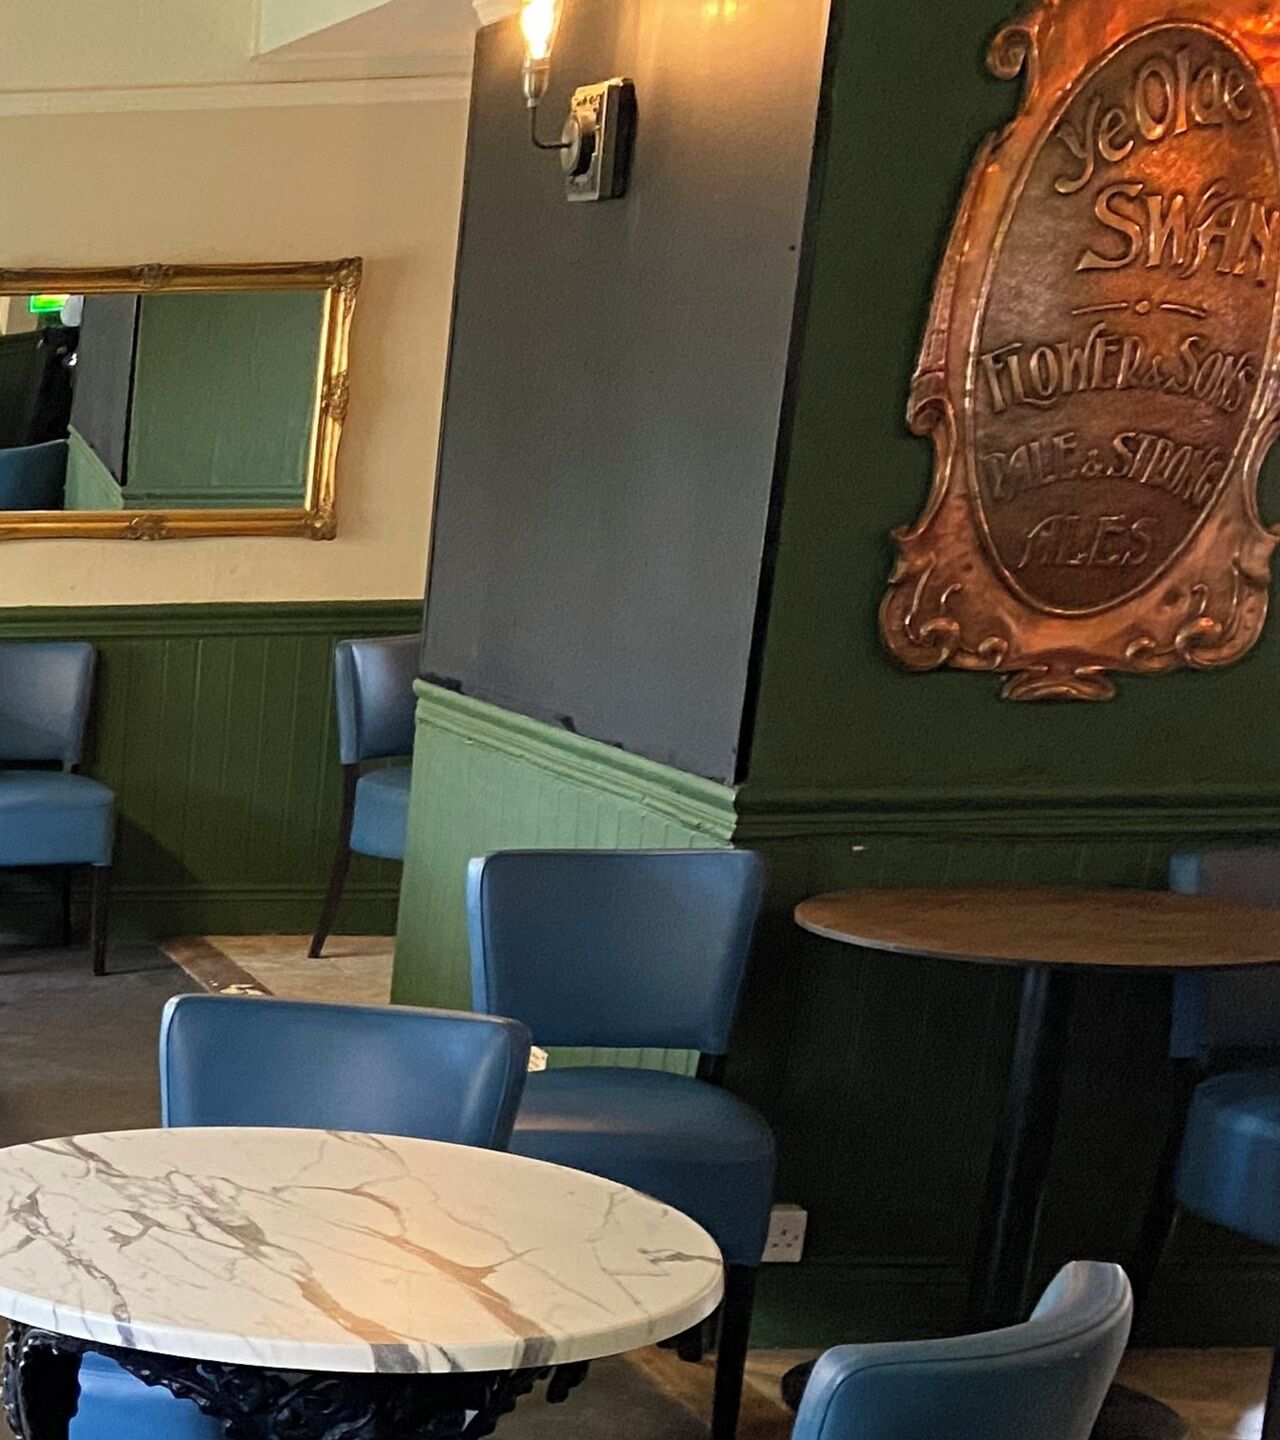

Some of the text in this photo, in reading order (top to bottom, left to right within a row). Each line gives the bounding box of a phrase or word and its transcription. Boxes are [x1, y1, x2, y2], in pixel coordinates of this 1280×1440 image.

[1074, 177, 1280, 279] SWAN
[980, 322, 1142, 413] FLOWER
[980, 431, 1080, 500] PALE
[1106, 431, 1226, 503] STRONG
[1017, 513, 1161, 569] ALES
